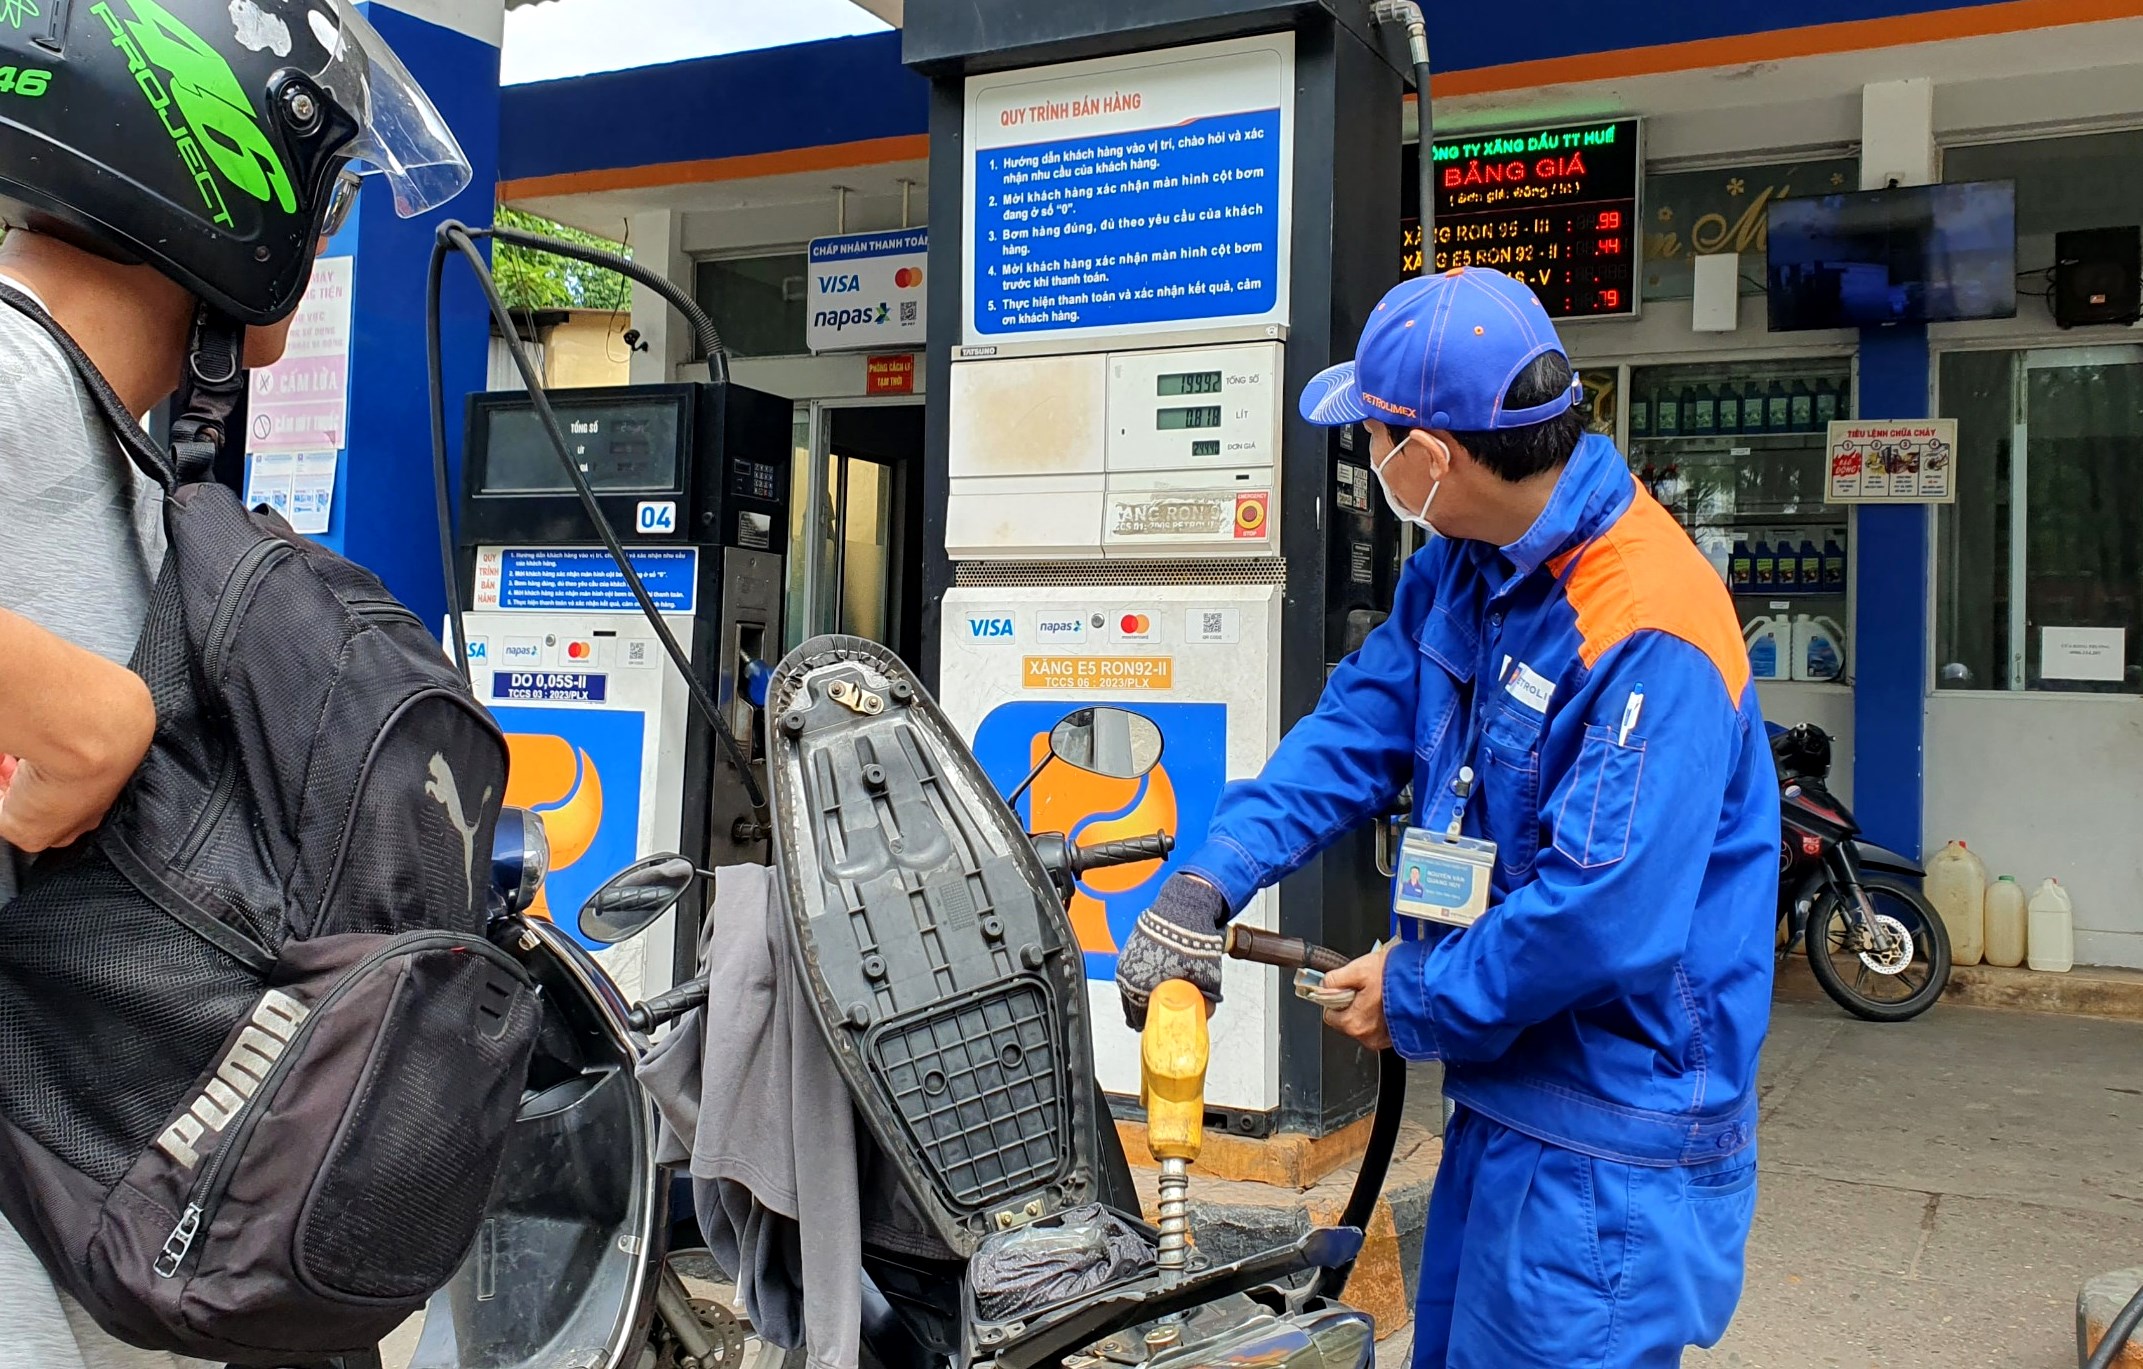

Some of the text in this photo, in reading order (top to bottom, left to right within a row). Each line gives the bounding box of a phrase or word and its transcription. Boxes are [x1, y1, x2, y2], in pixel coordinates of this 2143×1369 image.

[89, 2, 234, 229] PROJECT
[1001, 91, 1141, 126] QUY TRÌNH BÁN HÀNG
[989, 160, 998, 170] 1.
[1003, 156, 1039, 169] Hướng
[1041, 151, 1060, 165] dẫn
[1063, 148, 1094, 162] khách
[1097, 145, 1123, 157] hàng
[1126, 142, 1145, 154] vào
[1148, 140, 1158, 153] vị
[1178, 135, 1205, 148] chào
[1208, 132, 1225, 144] hỏi
[1228, 130, 1241, 142] và
[1244, 128, 1264, 139] xác
[1463, 143, 1481, 157] TY
[1484, 138, 1524, 155] XĂNG
[1563, 132, 1580, 147] TT
[1003, 158, 1160, 185] nhận nhu cầu của khách hàng.
[1536, 152, 1585, 177] GIÁ
[988, 196, 998, 207] 2.
[1003, 193, 1024, 205] Mời
[1027, 189, 1061, 202] khách
[1064, 186, 1093, 199] hàng
[1097, 183, 1117, 195] xác
[1120, 180, 1149, 193] nhận
[1153, 177, 1178, 189] màn
[1212, 170, 1233, 184] cột
[1236, 167, 1264, 179] bơm
[1003, 208, 1028, 222] đang
[1031, 206, 1040, 218] ở
[1041, 203, 1054, 216] số
[988, 203, 1263, 242] 3. Bơm hàng đúng, đủ theo yêu cầu của khách
[1457, 223, 1493, 241] RON
[813, 242, 839, 257] CHẤP
[840, 242, 868, 255] NHẬN
[870, 238, 903, 250] THANH
[1002, 244, 1030, 256] hàng.
[1453, 250, 1471, 266] E5
[1476, 246, 1511, 265] RON
[1516, 245, 1533, 261] 92
[988, 265, 997, 276] 4.
[1002, 263, 1023, 275] Mời
[1026, 258, 1060, 272] khách
[1064, 258, 1092, 269] hàng
[1096, 256, 1115, 267] xác
[1119, 252, 1148, 265] nhận
[1152, 249, 1177, 261] màn
[1211, 243, 1231, 257] cột
[1234, 242, 1263, 254] bơm
[817, 274, 860, 294] VISA
[1002, 271, 1109, 290] trước khi thanh toán.
[988, 278, 1261, 311] 5. Thực hiện thanh toán và xác nhận kết quả, cảm
[814, 306, 873, 331] napas
[1002, 310, 1080, 325] ơn khách hàng.
[962, 347, 995, 356] TATSUNO
[1226, 376, 1246, 385] TỔNG
[1249, 374, 1259, 384] SỐ
[1236, 409, 1248, 419] LÍT
[1362, 392, 1416, 418] PETROLIMEX
[570, 420, 588, 434] TỔNG
[589, 420, 599, 434] SỐ
[1244, 442, 1256, 450] GIÁ
[641, 506, 671, 528] 04
[483, 554, 497, 562] QUY
[481, 579, 495, 589] BÁN
[478, 594, 497, 604] HÀNG
[967, 619, 1013, 636] VISA
[1040, 622, 1072, 634] napas
[506, 647, 530, 657] napas
[1030, 659, 1167, 675] XĂNG E5 RON92-II
[512, 673, 587, 689] DO 0,05S-II
[1045, 677, 1149, 688] TCCS 06 2023/PLX
[508, 689, 588, 700] TCCS 03 2023/PLX
[157, 989, 310, 1170] PUMA
